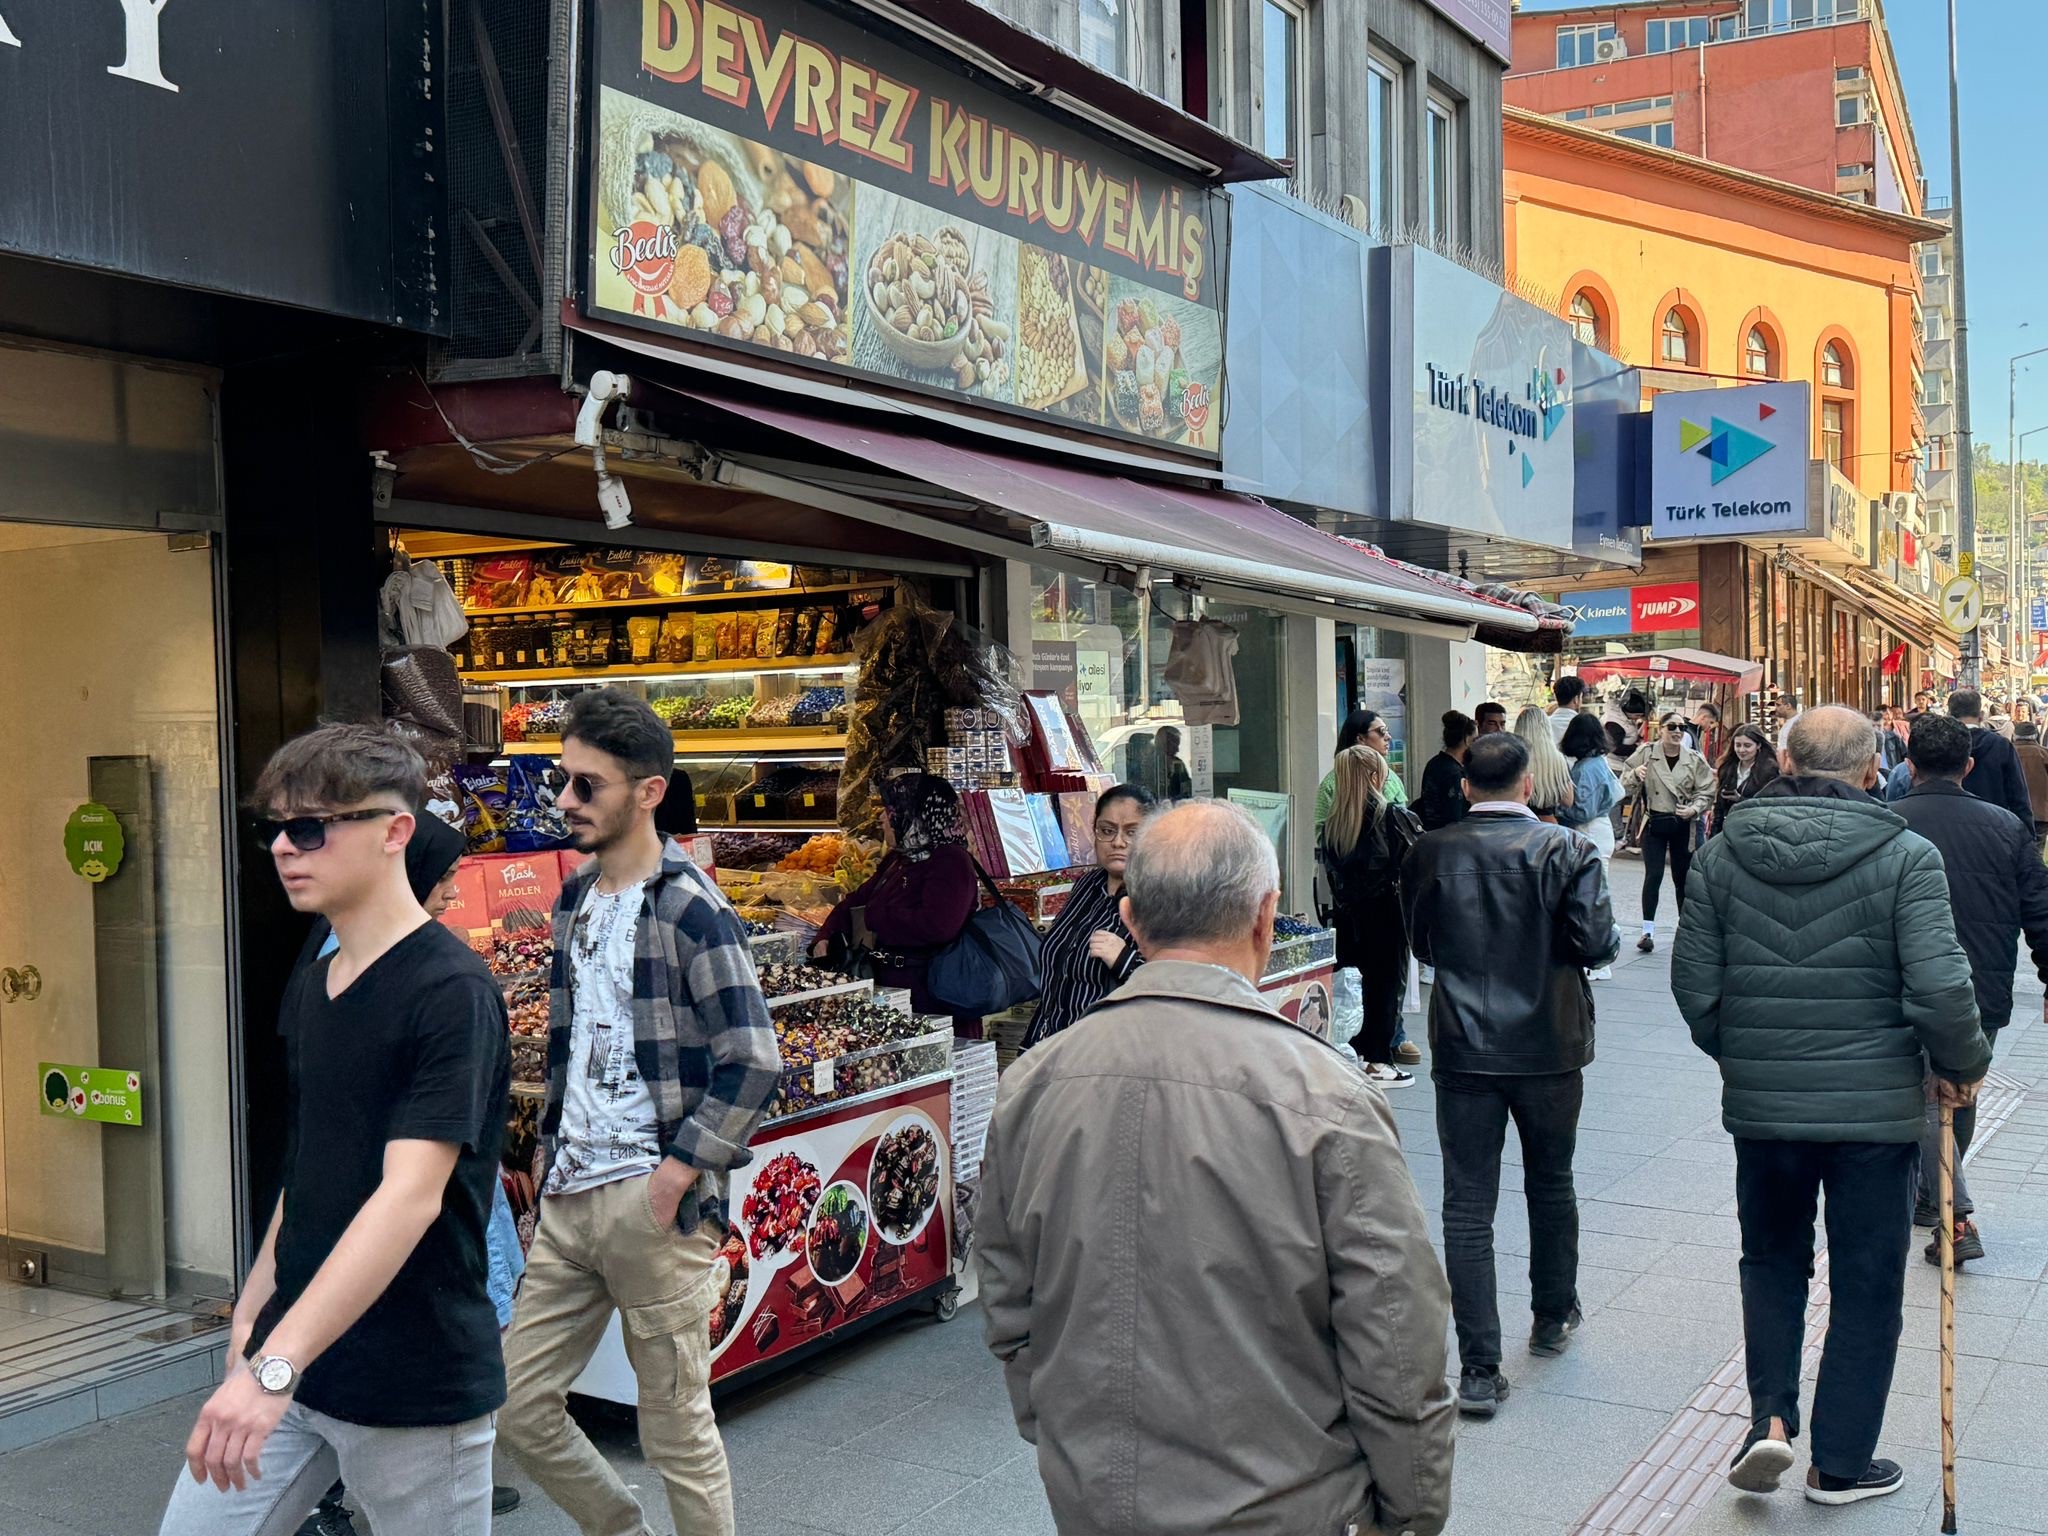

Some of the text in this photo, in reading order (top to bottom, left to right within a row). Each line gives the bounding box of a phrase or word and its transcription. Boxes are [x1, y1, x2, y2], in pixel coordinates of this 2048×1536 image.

[642, 0, 1205, 303] DEVREZ KURUYEMİŞ
[1425, 362, 1538, 439] Türk Telekom
[1666, 500, 1791, 521] Türk Telekom
[1587, 600, 1678, 620] kinetix JUMP
[501, 862, 537, 885] Flash
[498, 884, 541, 898] MADLEN
